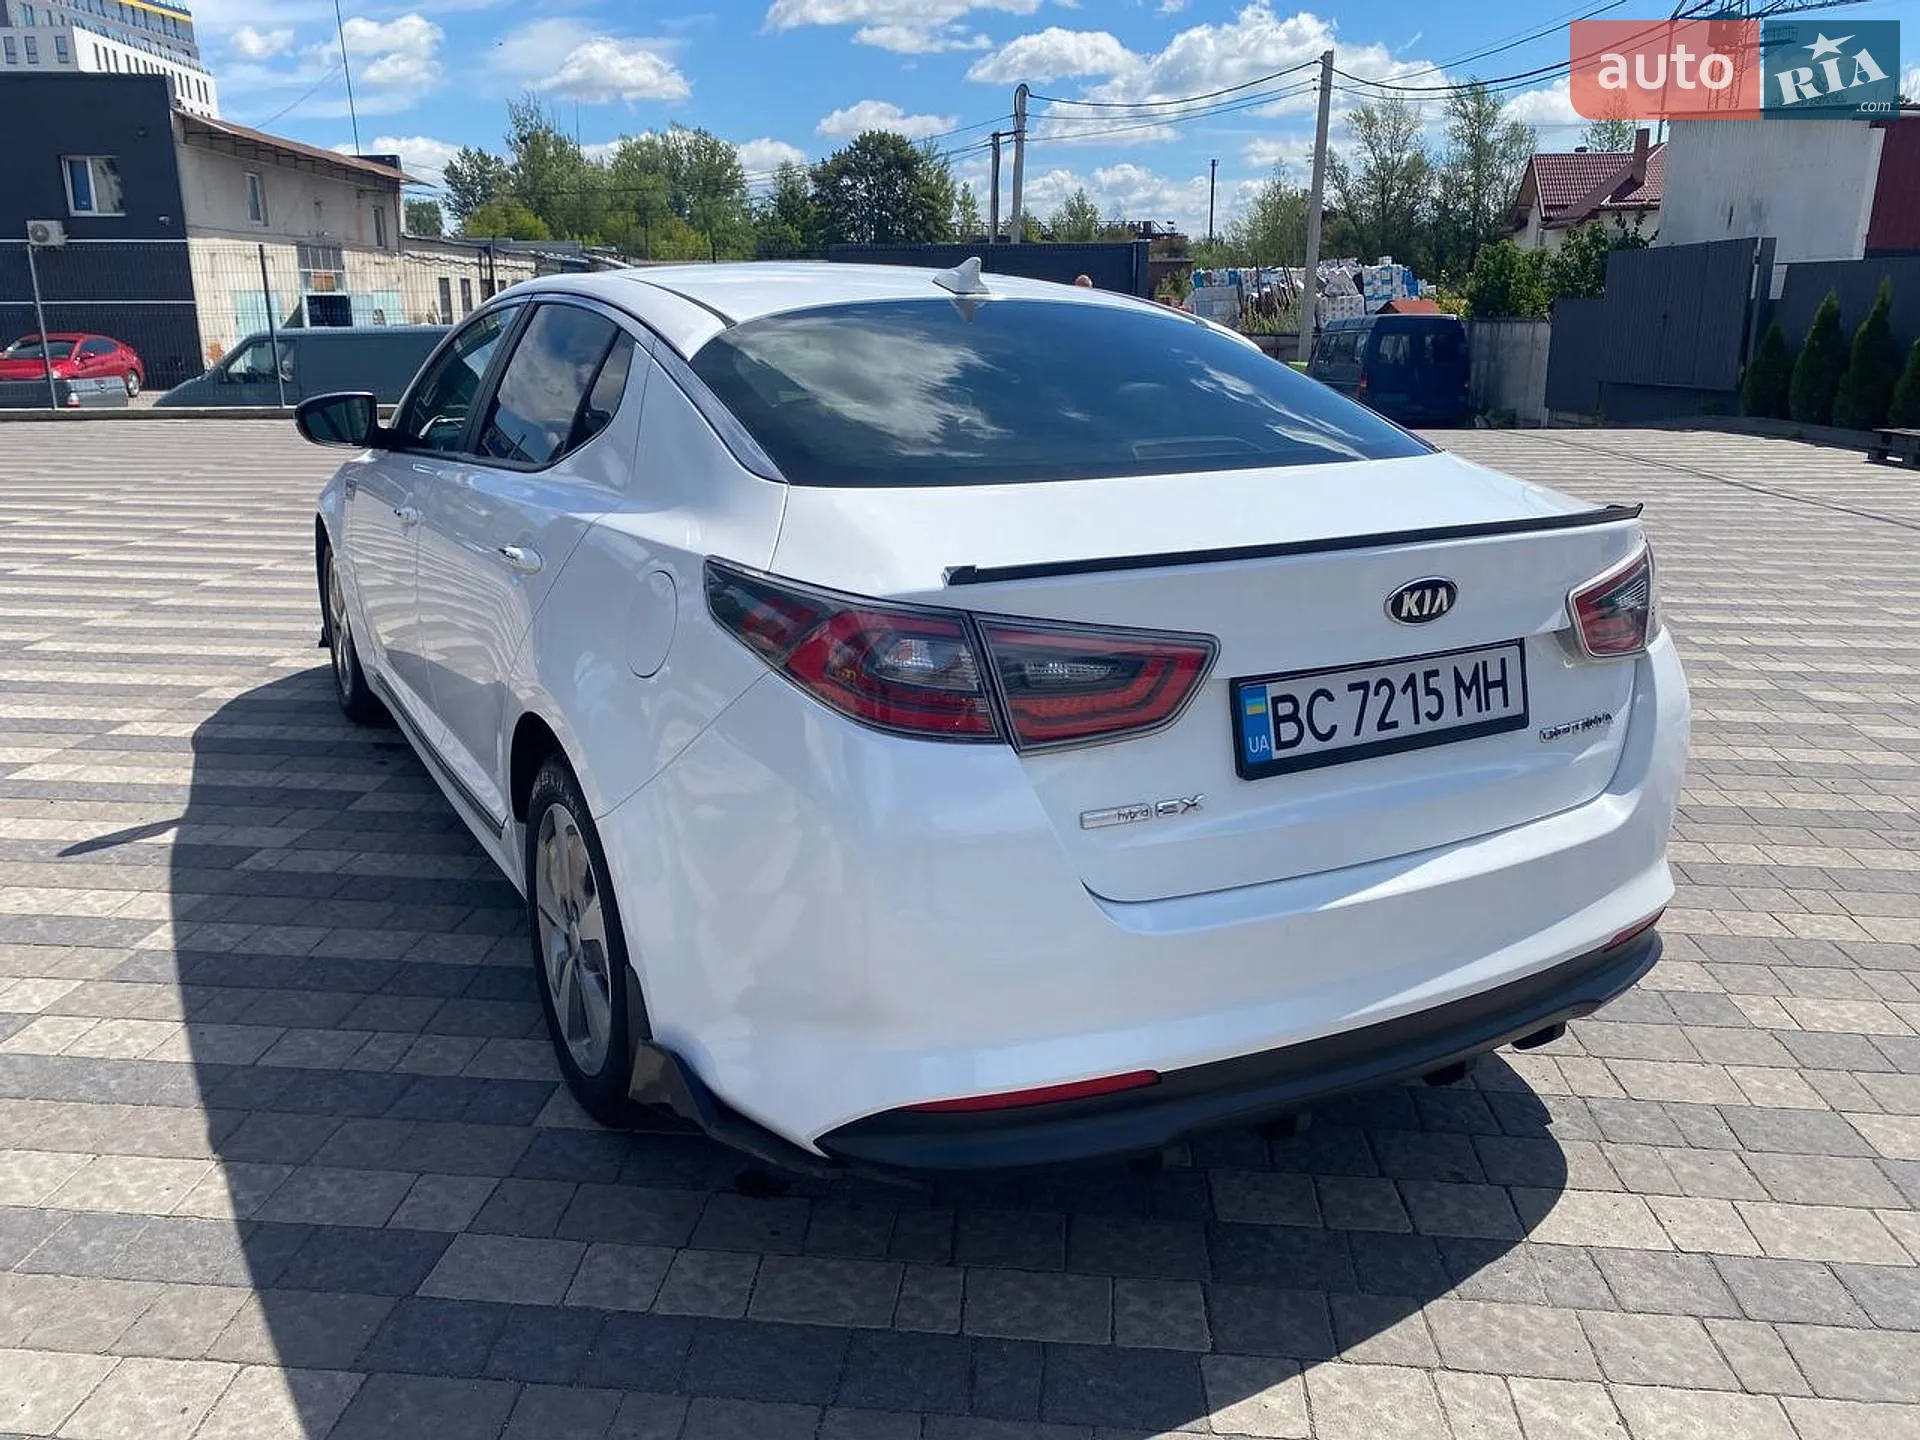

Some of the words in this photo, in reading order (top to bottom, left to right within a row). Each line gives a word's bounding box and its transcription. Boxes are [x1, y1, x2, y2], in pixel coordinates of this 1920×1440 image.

[1401, 587, 1449, 617] KIA
[1271, 688, 1338, 750] BC
[1348, 668, 1444, 737] 7215
[1453, 656, 1510, 717] MH
[1249, 737, 1270, 753] UA
